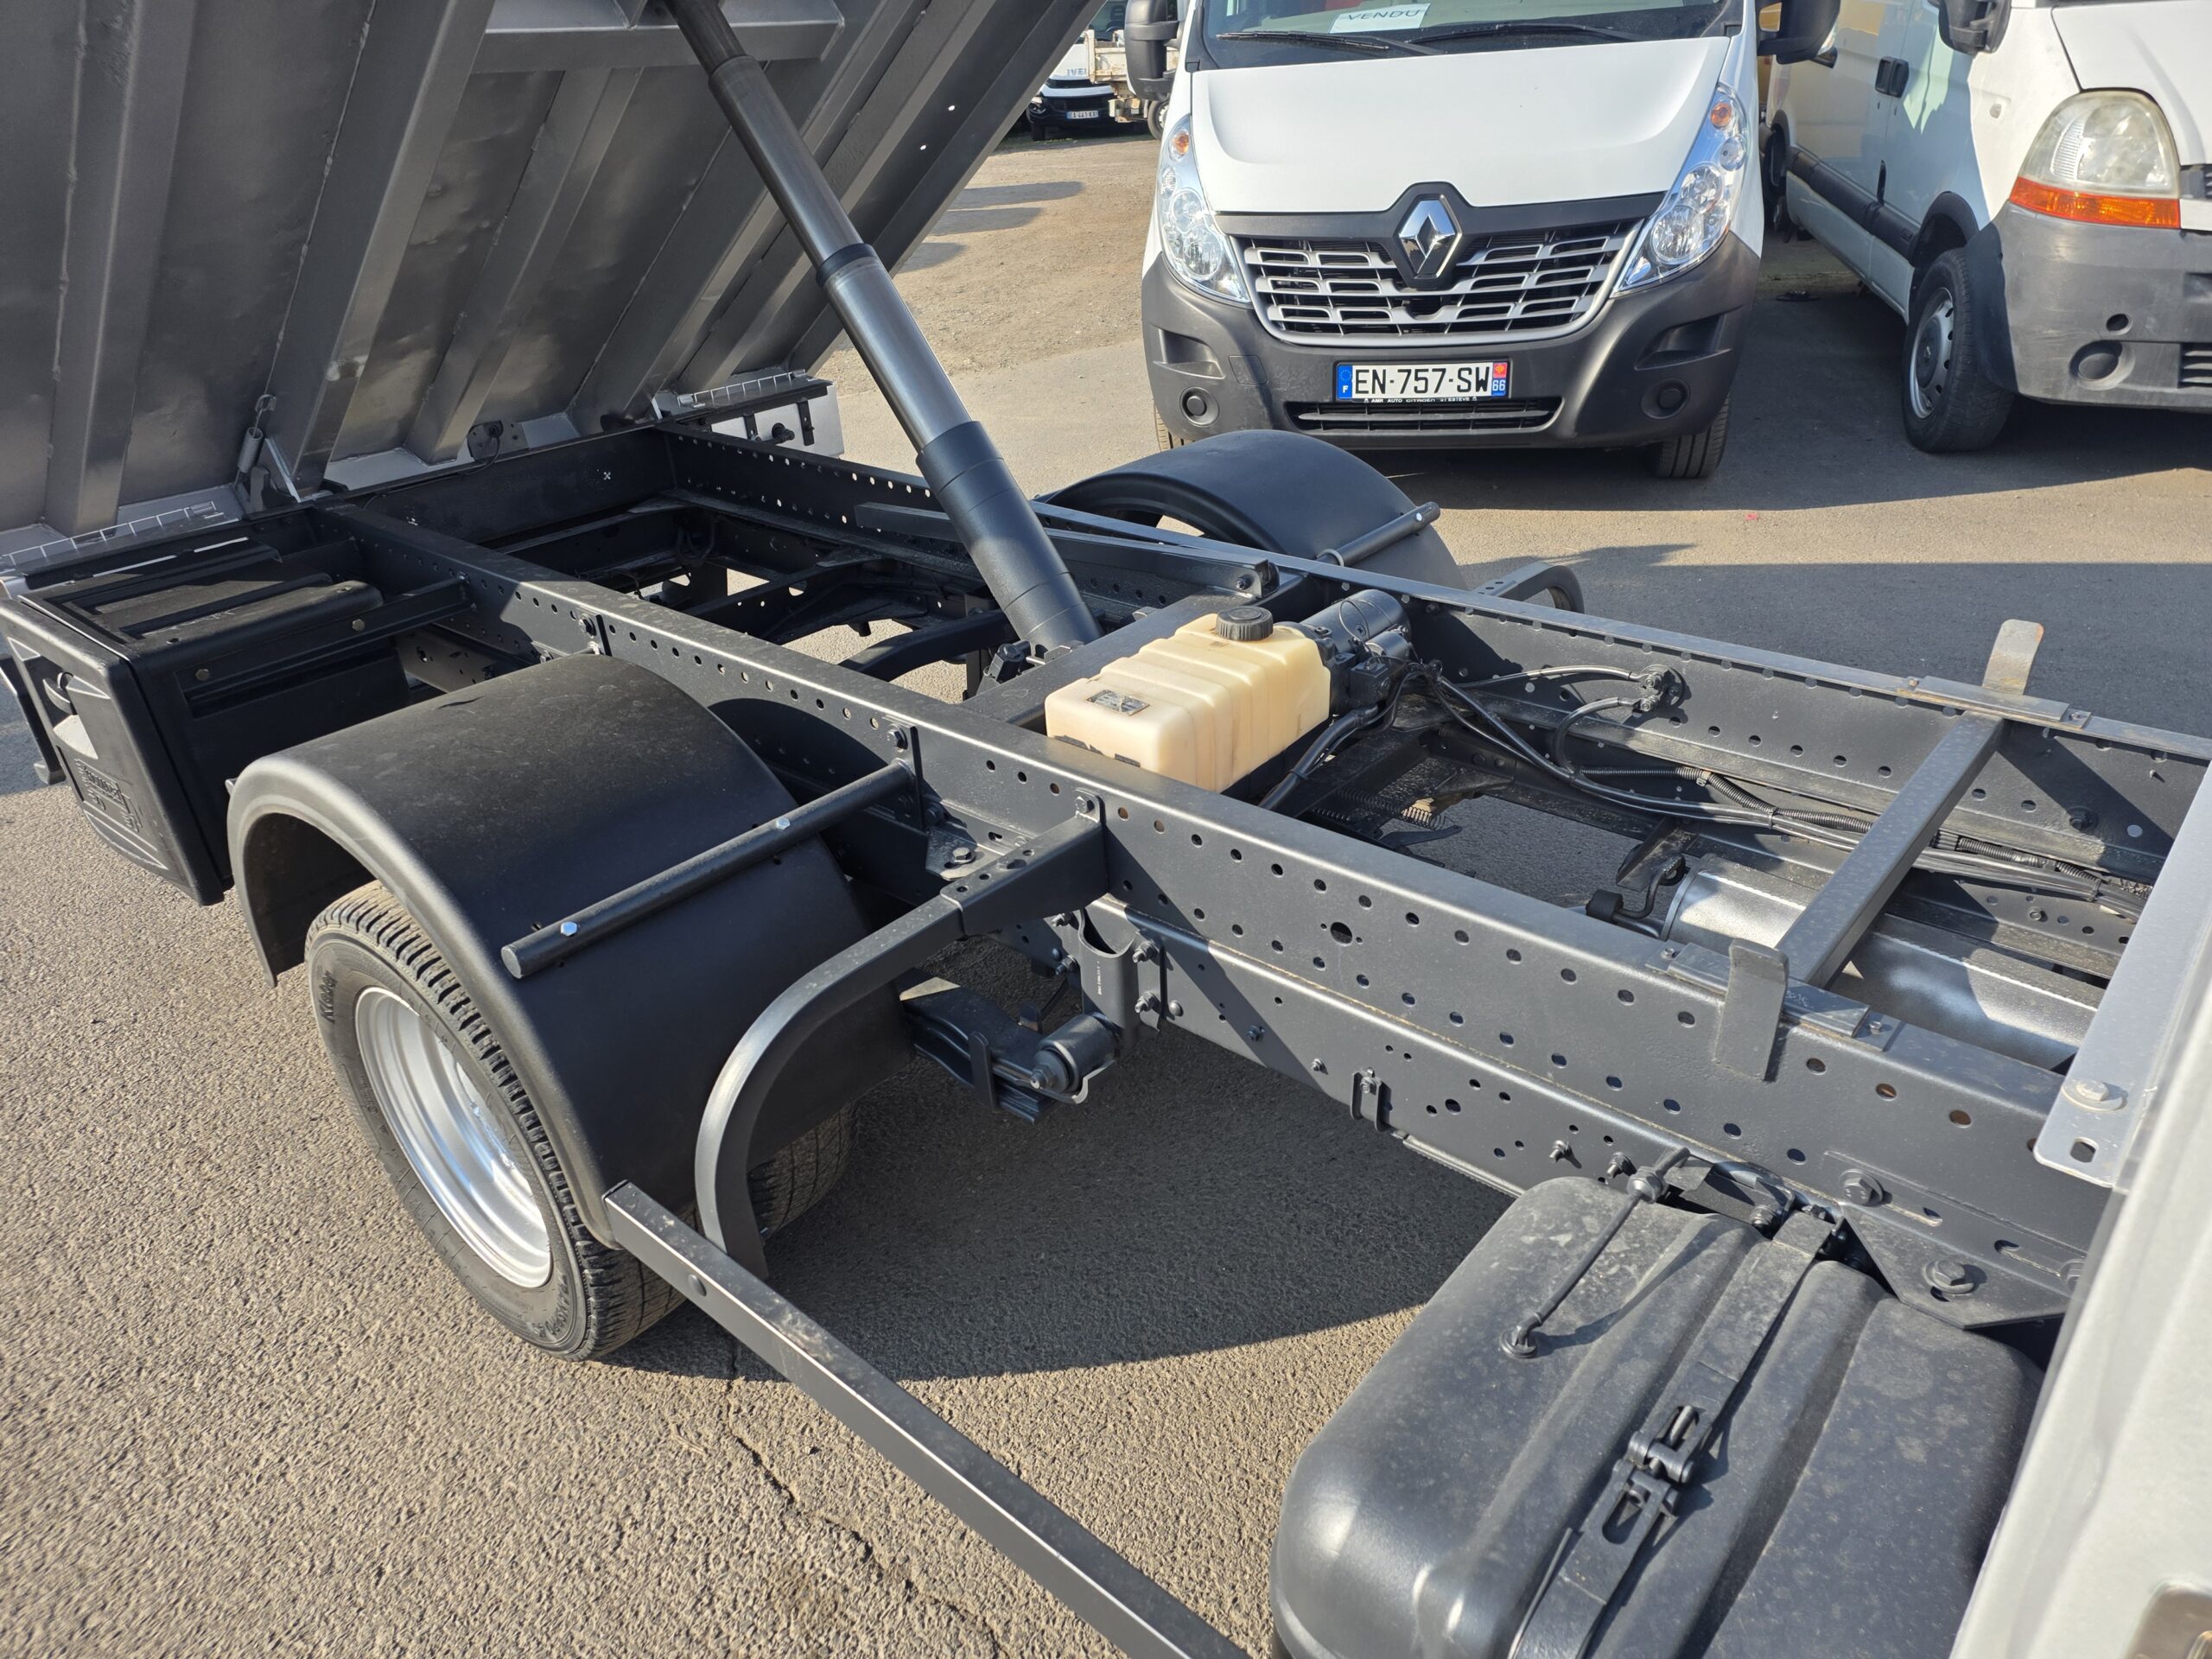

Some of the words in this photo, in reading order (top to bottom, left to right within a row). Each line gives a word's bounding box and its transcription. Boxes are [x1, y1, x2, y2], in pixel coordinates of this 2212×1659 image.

[1348, 10, 1420, 21] VENDU
[1067, 67, 1087, 76] IVE
[1354, 365, 1491, 395] EN-757-SW
[1492, 379, 1507, 391] 66
